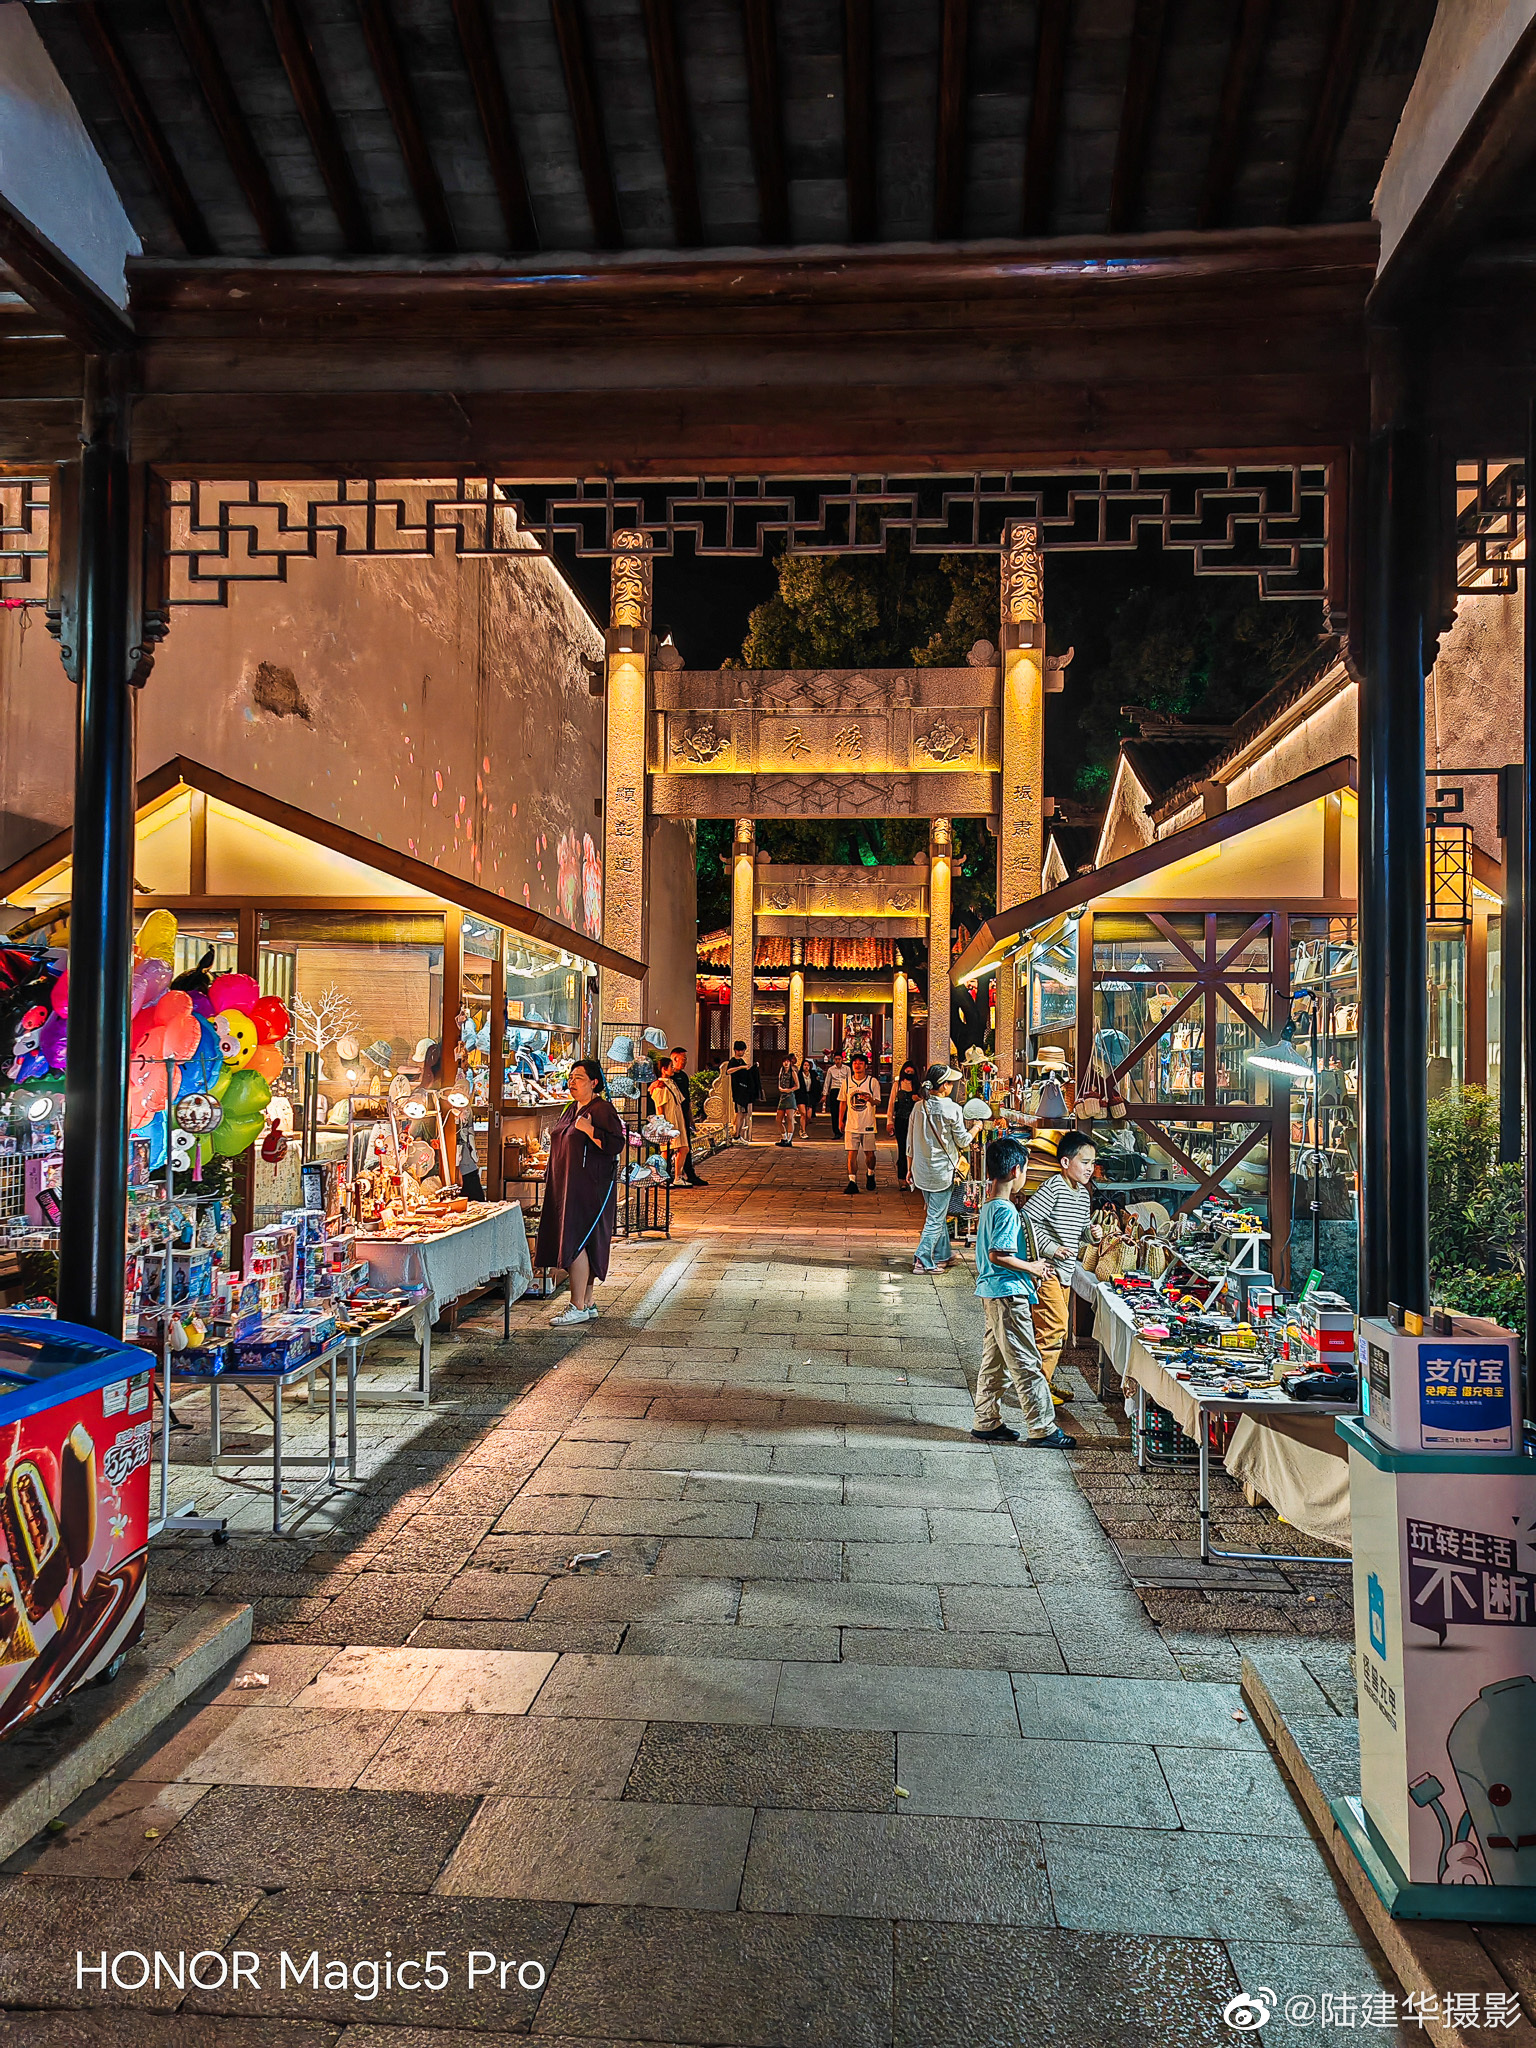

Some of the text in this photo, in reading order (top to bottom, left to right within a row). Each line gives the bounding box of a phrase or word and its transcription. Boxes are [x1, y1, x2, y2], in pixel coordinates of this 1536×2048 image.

[1425, 1358, 1503, 1383] 支付宝
[1425, 1385, 1504, 1397] 免押金 借充电宝
[1410, 1522, 1511, 1568] 玩转生活
[1412, 1557, 1536, 1622] 不断
